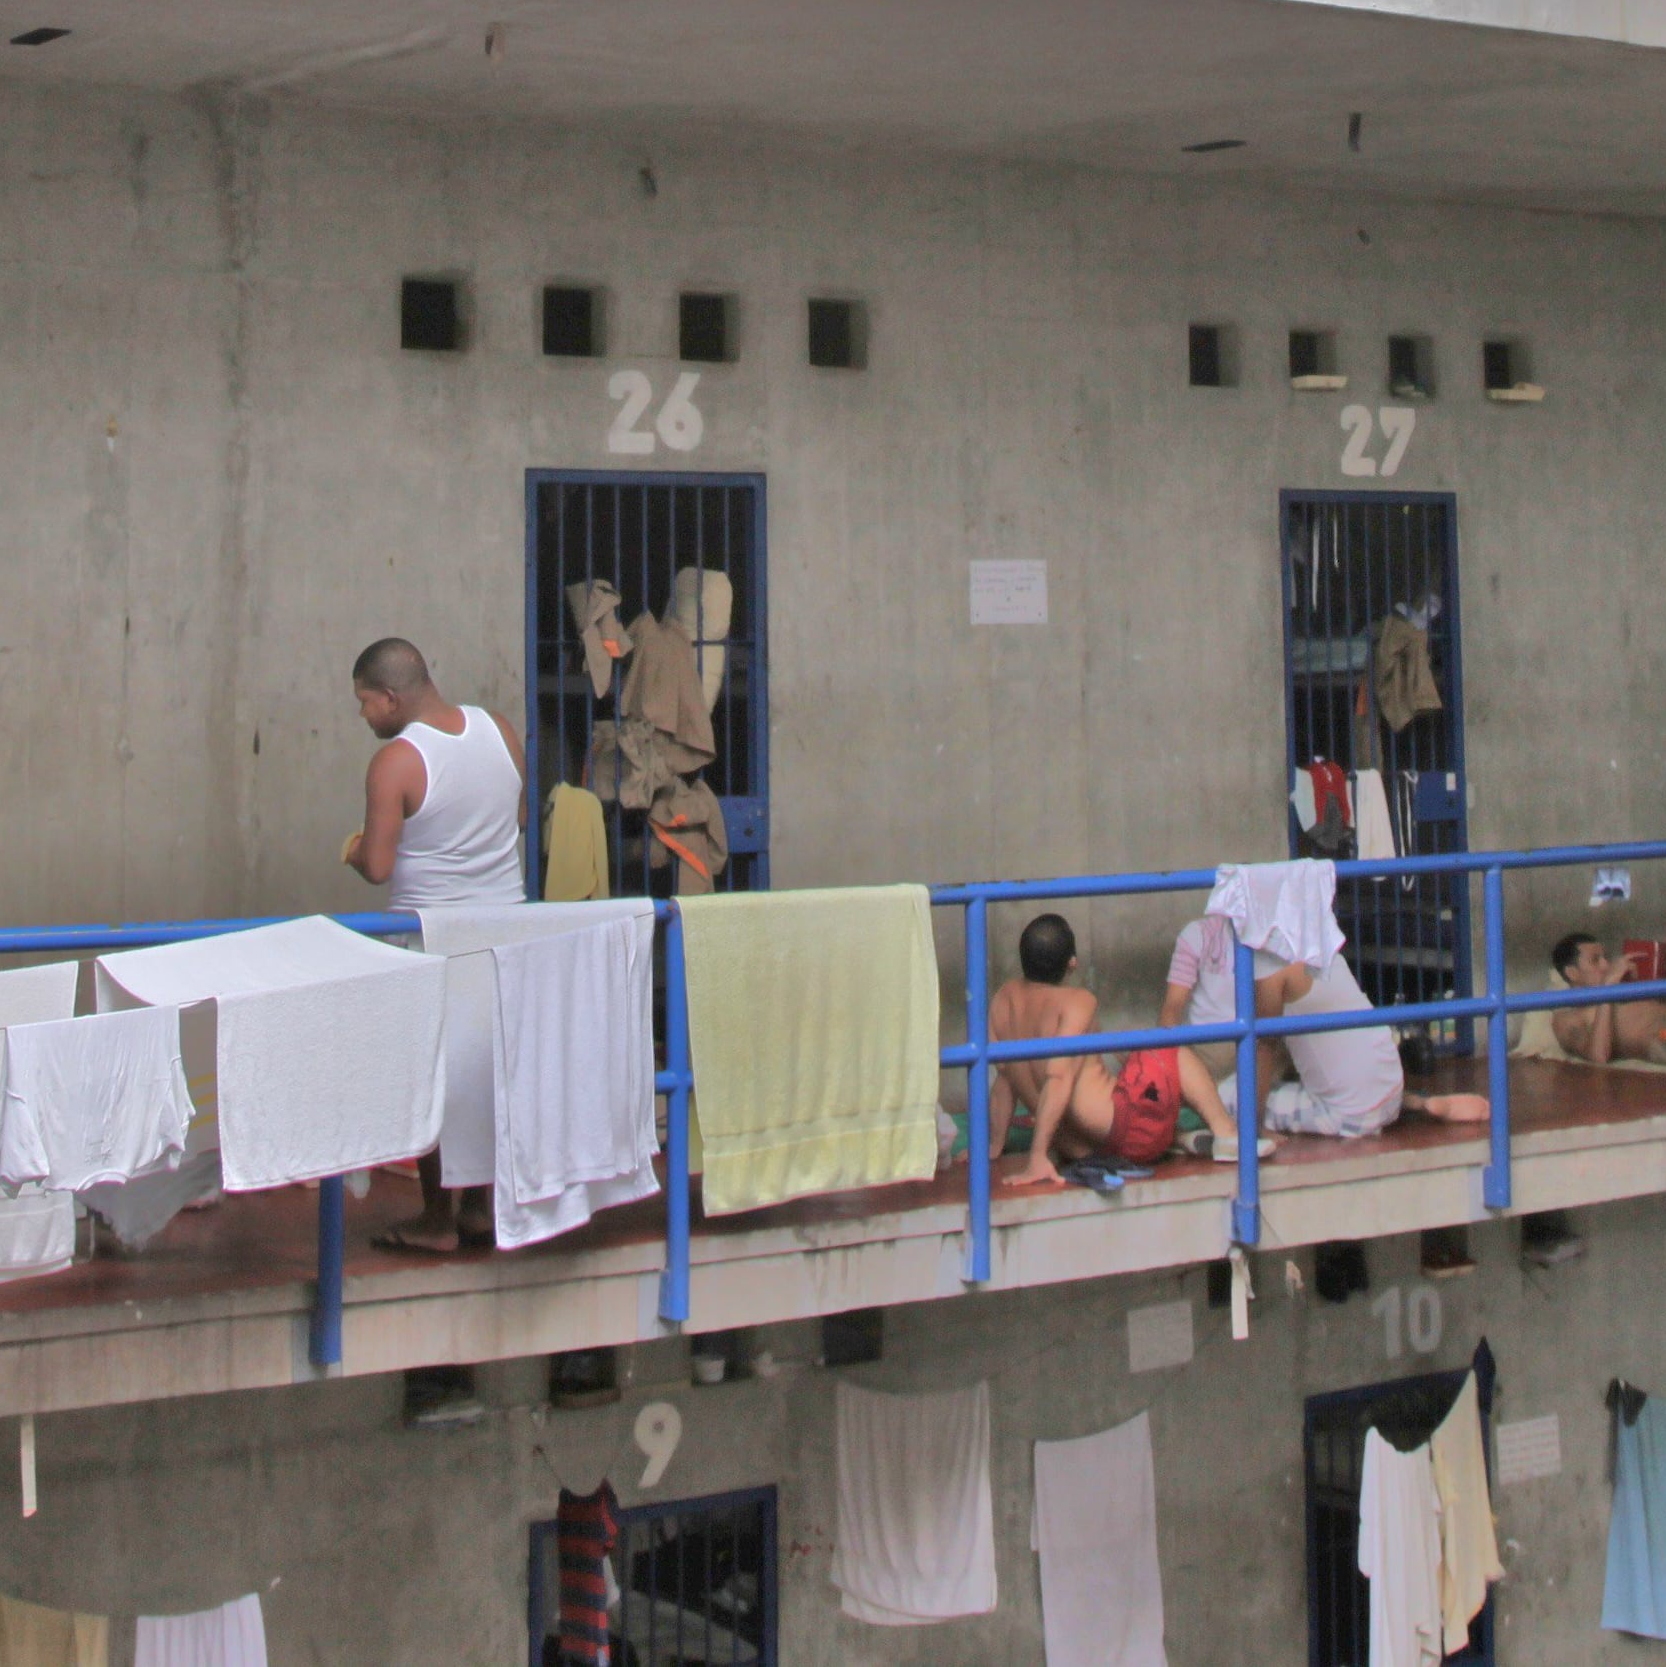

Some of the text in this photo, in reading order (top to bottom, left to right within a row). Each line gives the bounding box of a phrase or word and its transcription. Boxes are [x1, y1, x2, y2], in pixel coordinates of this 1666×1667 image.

[608, 370, 704, 454] 26
[1340, 404, 1416, 476] 27
[1371, 1285, 1443, 1360] 10
[632, 1402, 683, 1489] 9
